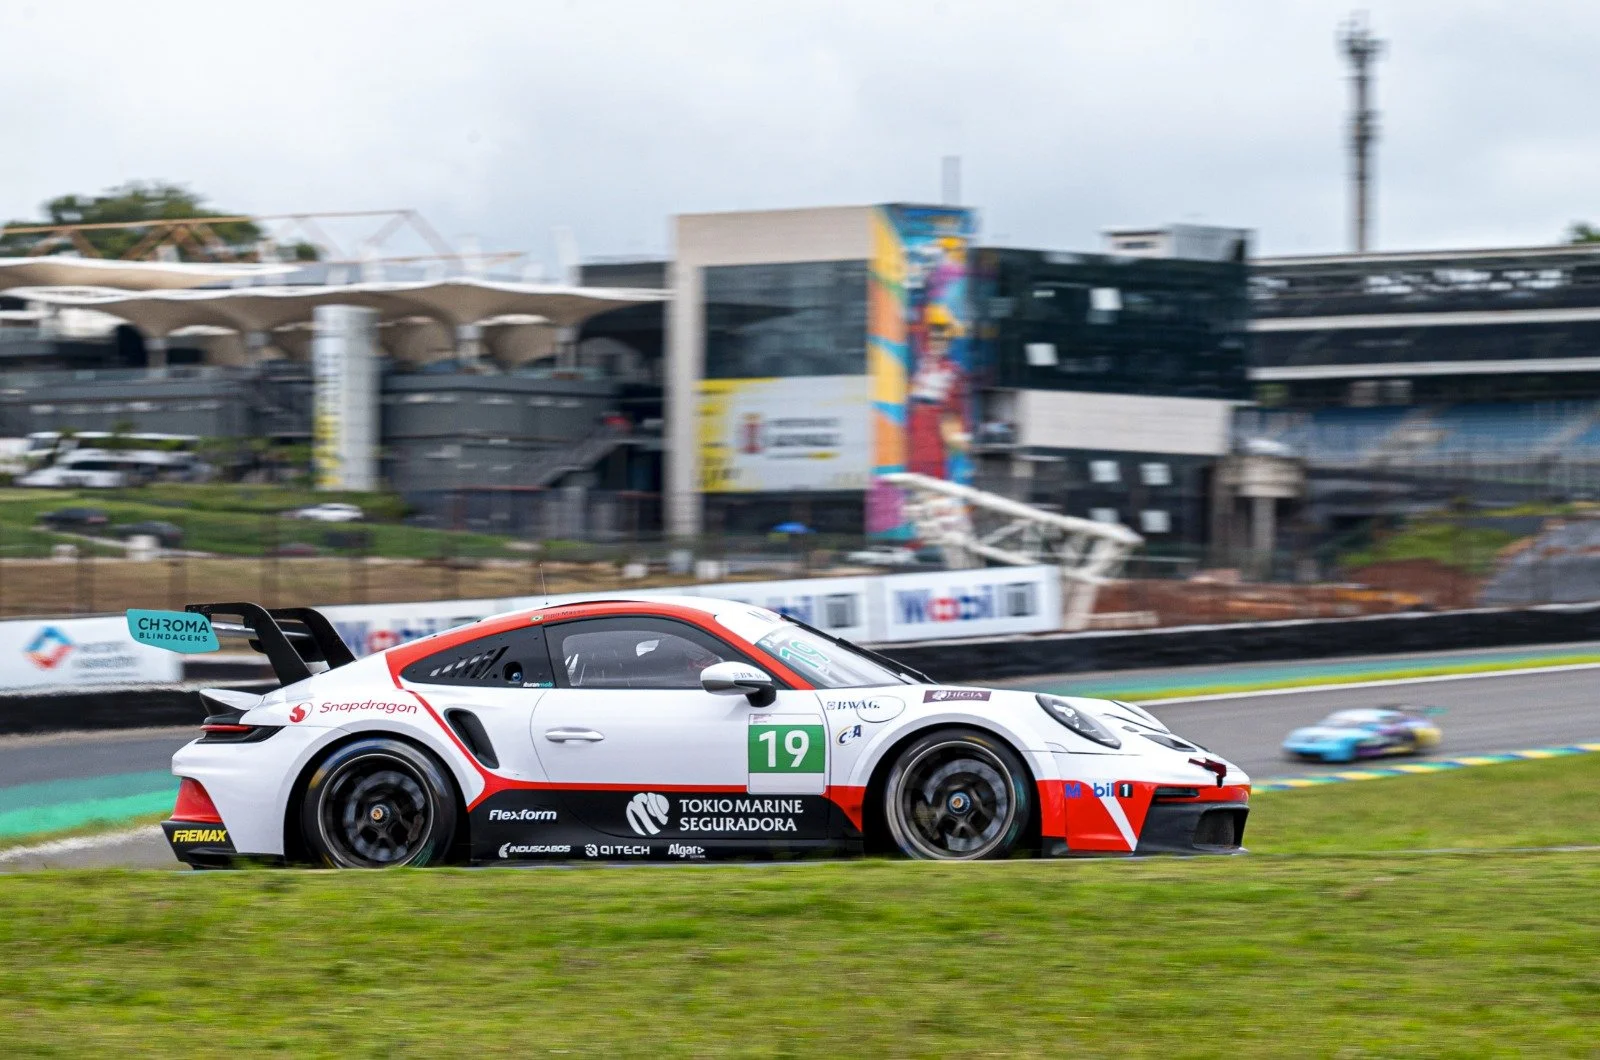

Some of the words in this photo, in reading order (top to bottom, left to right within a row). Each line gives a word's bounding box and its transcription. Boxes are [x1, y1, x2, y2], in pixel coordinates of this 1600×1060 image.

[138, 617, 209, 633] CHROMA
[139, 632, 208, 642] BLINDAGENS
[780, 640, 831, 670] 19
[319, 700, 417, 714] Snapdragon
[758, 729, 810, 768] 19
[1065, 782, 1115, 798] Mbil
[679, 799, 733, 814] TOKIO
[735, 799, 804, 814] MARINE
[489, 809, 557, 821] Flexform
[679, 817, 798, 832] SEGURADORA
[172, 829, 227, 843] FREMAX
[509, 845, 571, 853] INDUSCABOS
[668, 843, 697, 858] Algar
